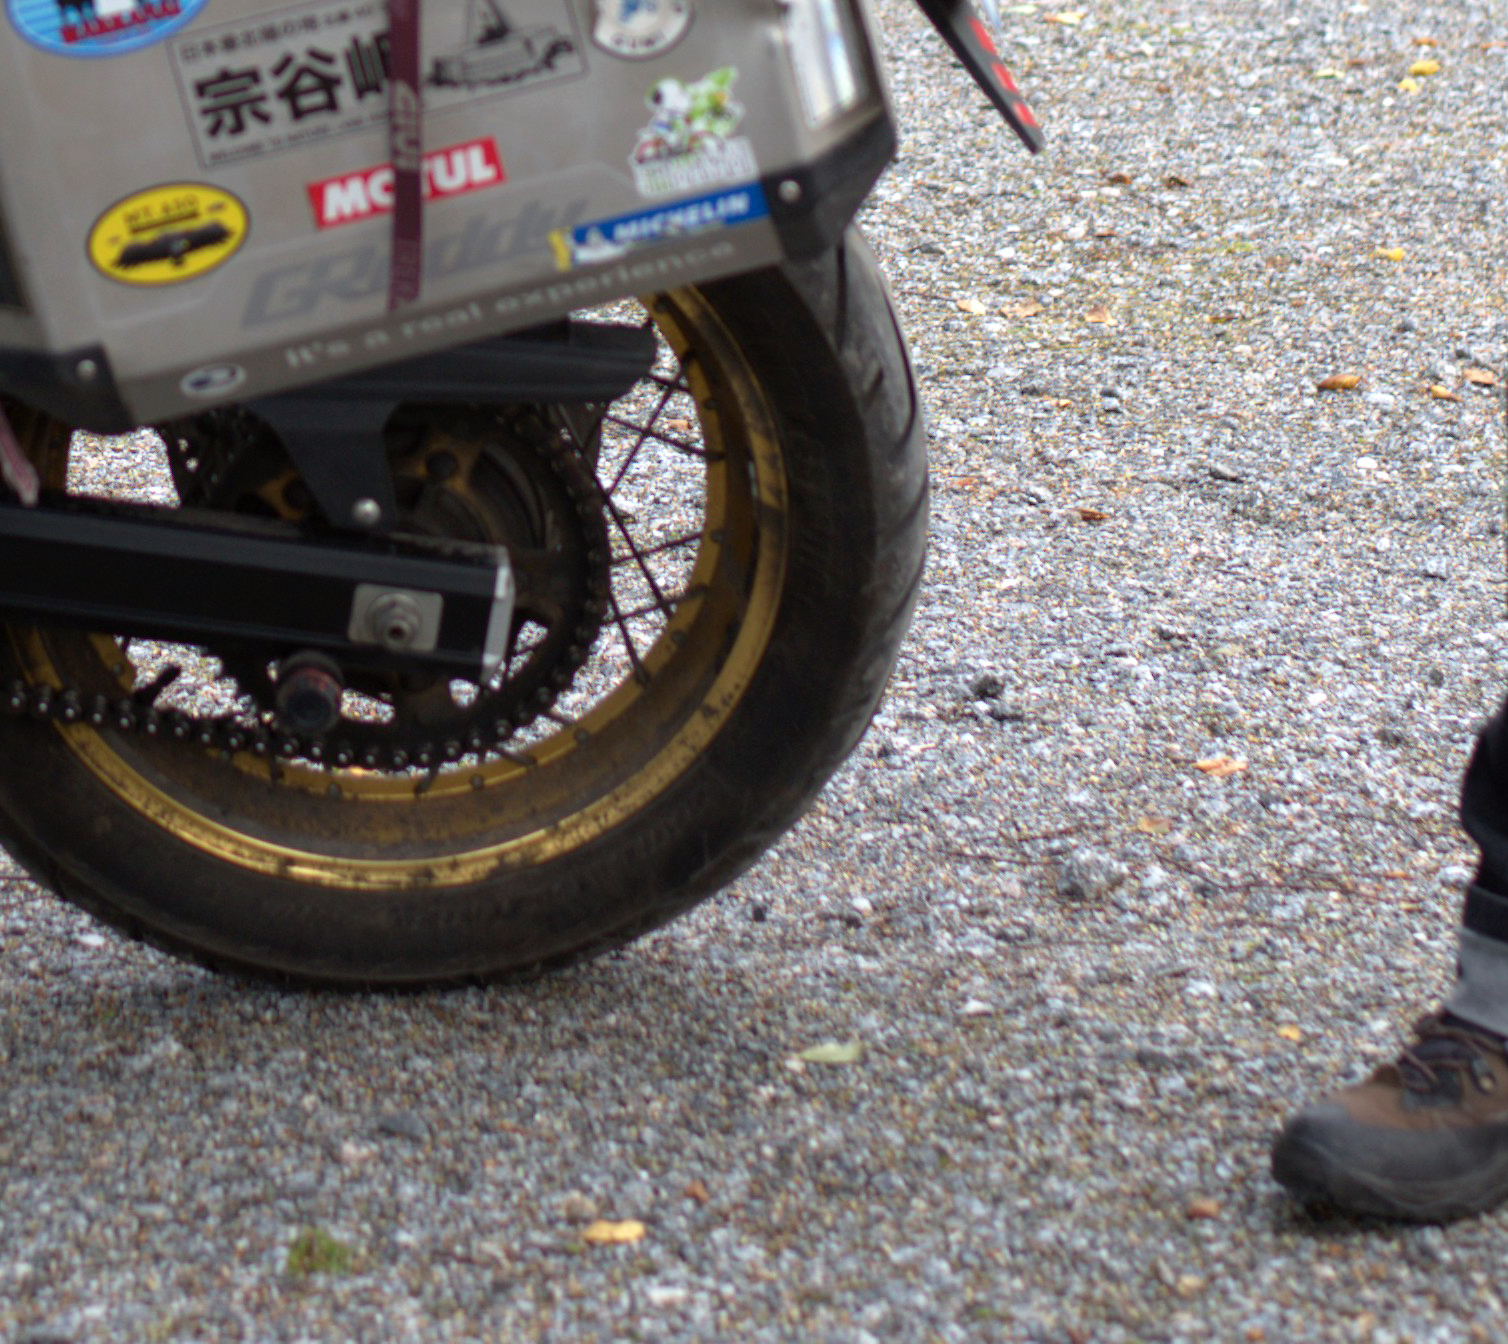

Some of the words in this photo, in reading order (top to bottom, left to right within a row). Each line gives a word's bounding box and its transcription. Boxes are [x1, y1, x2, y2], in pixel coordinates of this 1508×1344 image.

[323, 143, 496, 223] MOUL
[613, 191, 751, 243] MICHELIN
[285, 338, 351, 370] It's
[364, 326, 390, 349] a
[402, 305, 482, 339] real
[493, 241, 736, 316] experience
